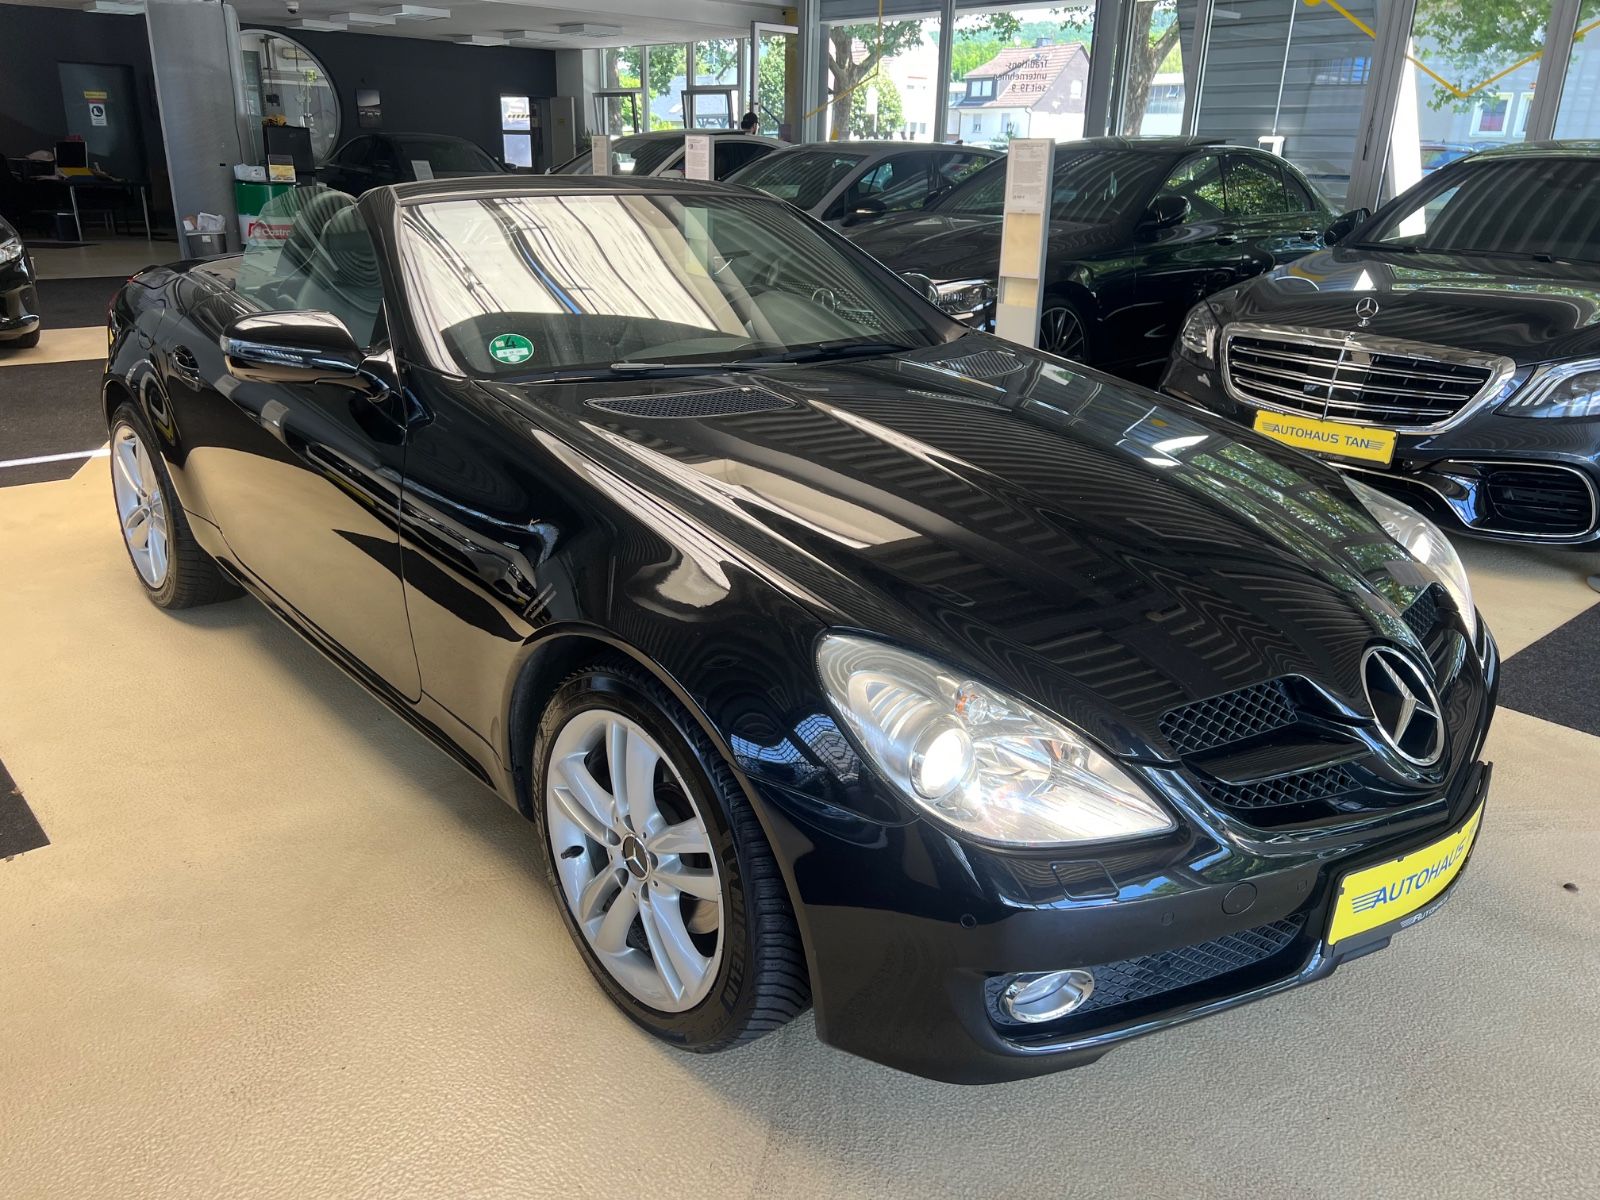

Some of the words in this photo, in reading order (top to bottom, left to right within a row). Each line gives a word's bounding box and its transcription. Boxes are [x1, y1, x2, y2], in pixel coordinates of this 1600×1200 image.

[505, 336, 517, 348] 4
[1272, 424, 1339, 443] AUTOHAUS
[1344, 435, 1370, 449] TAN
[1371, 844, 1464, 908] AUTOHAUS
